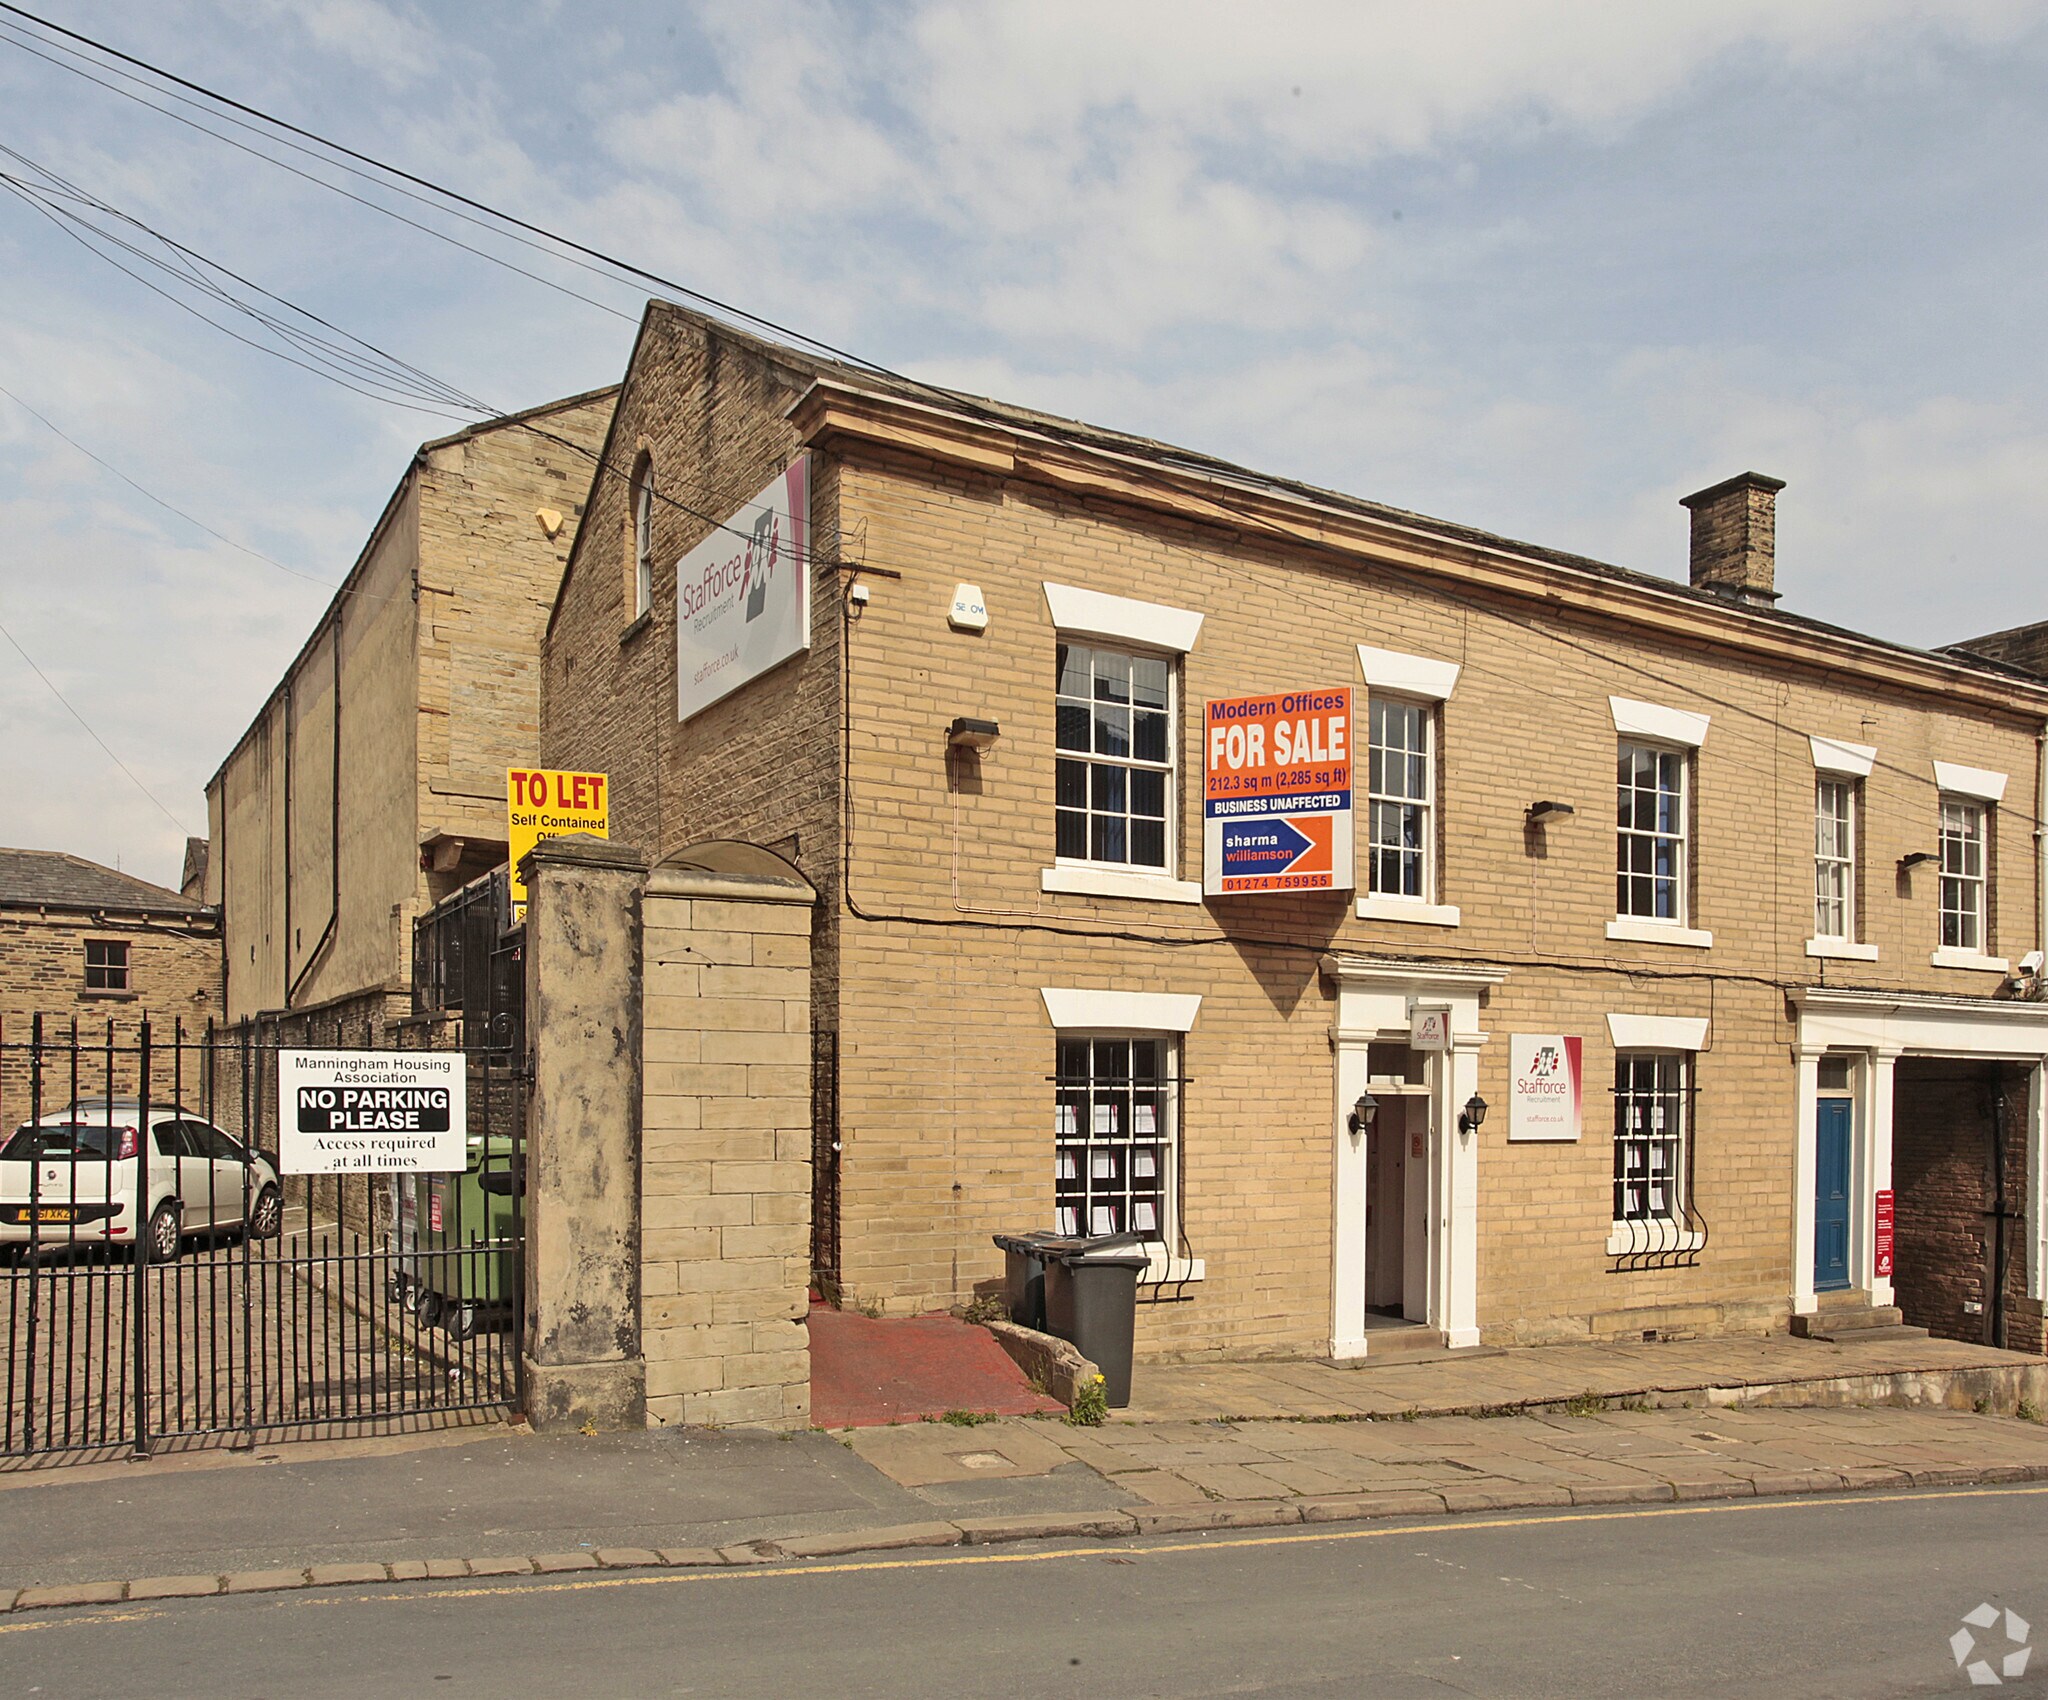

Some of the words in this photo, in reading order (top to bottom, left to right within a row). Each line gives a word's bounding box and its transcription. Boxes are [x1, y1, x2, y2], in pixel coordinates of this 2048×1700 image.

[683, 553, 741, 620] Stafforce
[694, 594, 734, 635] Recruitment
[694, 643, 739, 686] stafforce.co.uk
[1211, 701, 1276, 720] Modern
[1281, 694, 1345, 714] Offices
[1210, 724, 1266, 770] FOR
[1274, 716, 1346, 766] SALE
[1210, 775, 1240, 791] 212.3
[1243, 777, 1258, 791] sq
[1261, 776, 1272, 787] m
[1276, 770, 1311, 790] (2,285
[1315, 773, 1330, 787] sq
[1333, 768, 1346, 785] ft)
[511, 772, 548, 808] TO
[557, 775, 604, 810] LET
[1214, 799, 1268, 814] BUSINESS
[1270, 795, 1341, 811] UNAFFECTED
[511, 813, 537, 826] Self
[541, 815, 605, 830] Contained
[1226, 835, 1278, 847] sharma
[1226, 848, 1293, 862] williamson
[1227, 878, 1269, 890] 01274
[1276, 876, 1327, 889] 759955
[1416, 1031, 1439, 1040] Stafforce
[295, 1057, 389, 1072] Manningham
[394, 1059, 451, 1073] Housing
[334, 1072, 417, 1083] Association
[1517, 1078, 1566, 1094] Stafforce
[300, 1090, 336, 1109] NO
[343, 1090, 447, 1109] PARKING
[1527, 1095, 1560, 1103] Recruitment
[329, 1111, 420, 1130] PLEASE
[1526, 1115, 1564, 1123] stafforce.co.uk
[313, 1137, 365, 1150] Access
[371, 1137, 436, 1152] required
[333, 1156, 348, 1167] at
[353, 1155, 371, 1167] all
[377, 1154, 418, 1167] times
